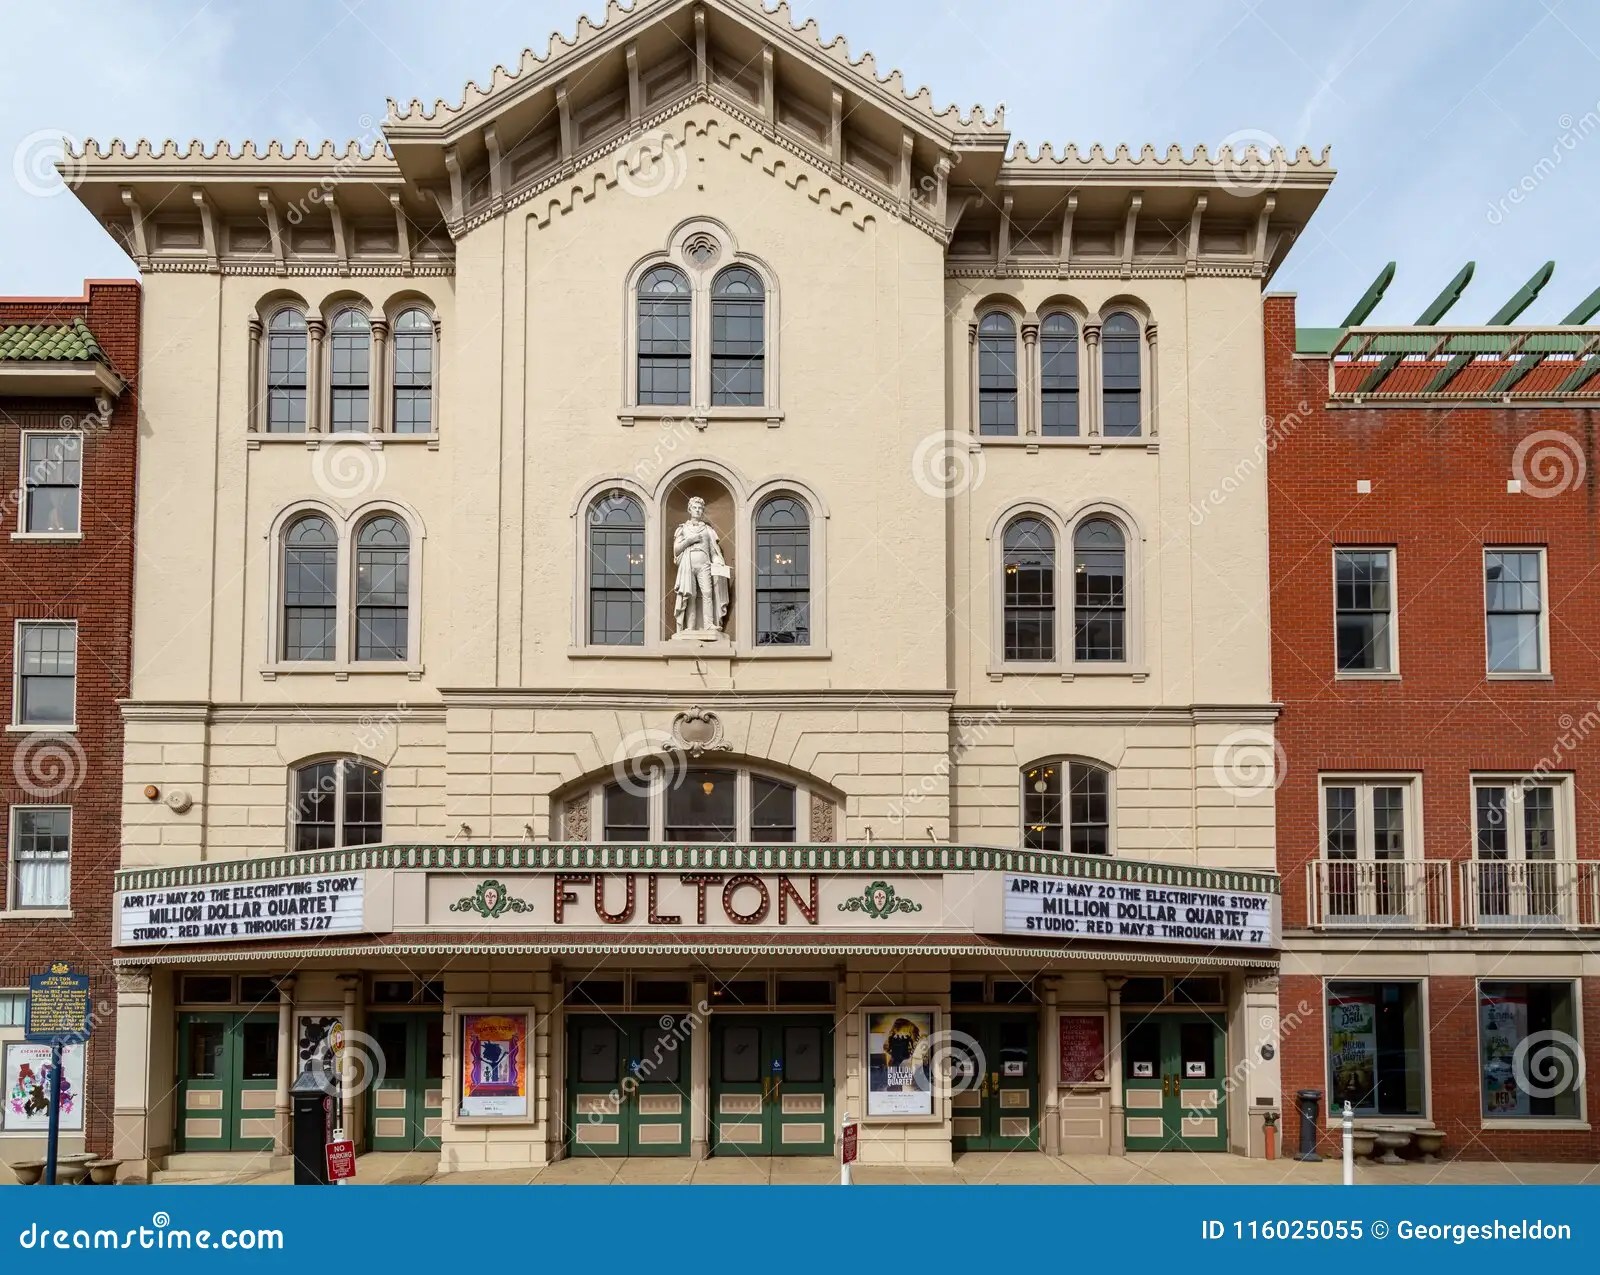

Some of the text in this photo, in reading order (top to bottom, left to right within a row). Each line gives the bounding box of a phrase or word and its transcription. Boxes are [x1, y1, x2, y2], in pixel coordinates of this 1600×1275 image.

[124, 894, 144, 908] APR
[166, 892, 188, 905] MAY
[190, 891, 205, 904] 20
[211, 888, 231, 901] THE
[233, 881, 312, 900] ELECTRIFYING
[317, 877, 358, 893] STORY
[554, 873, 818, 925] FULTON
[1011, 878, 1039, 894] APR
[1066, 883, 1093, 897] MAY
[1098, 885, 1116, 899] 20
[1119, 887, 1141, 901] THE
[1146, 889, 1225, 907] ELECTRIFYING
[1230, 896, 1268, 910] STORY
[149, 895, 339, 925] MILLION DOLLAR QUARTET
[1042, 897, 1249, 927] MILLION DOLLAR QUARTET
[179, 924, 199, 937] RED
[204, 922, 227, 936] MAY
[230, 922, 238, 935] 8
[244, 918, 296, 934] THROUGH
[300, 915, 333, 930] 5/27
[1026, 916, 1264, 943] STUDIO: RED MAY 8 THROUGH MAY 27
[888, 1078, 913, 1086] QUARTET
[1495, 1091, 1510, 1105] RED
[329, 1151, 352, 1161] PARKING
[334, 1144, 345, 1153] NO
